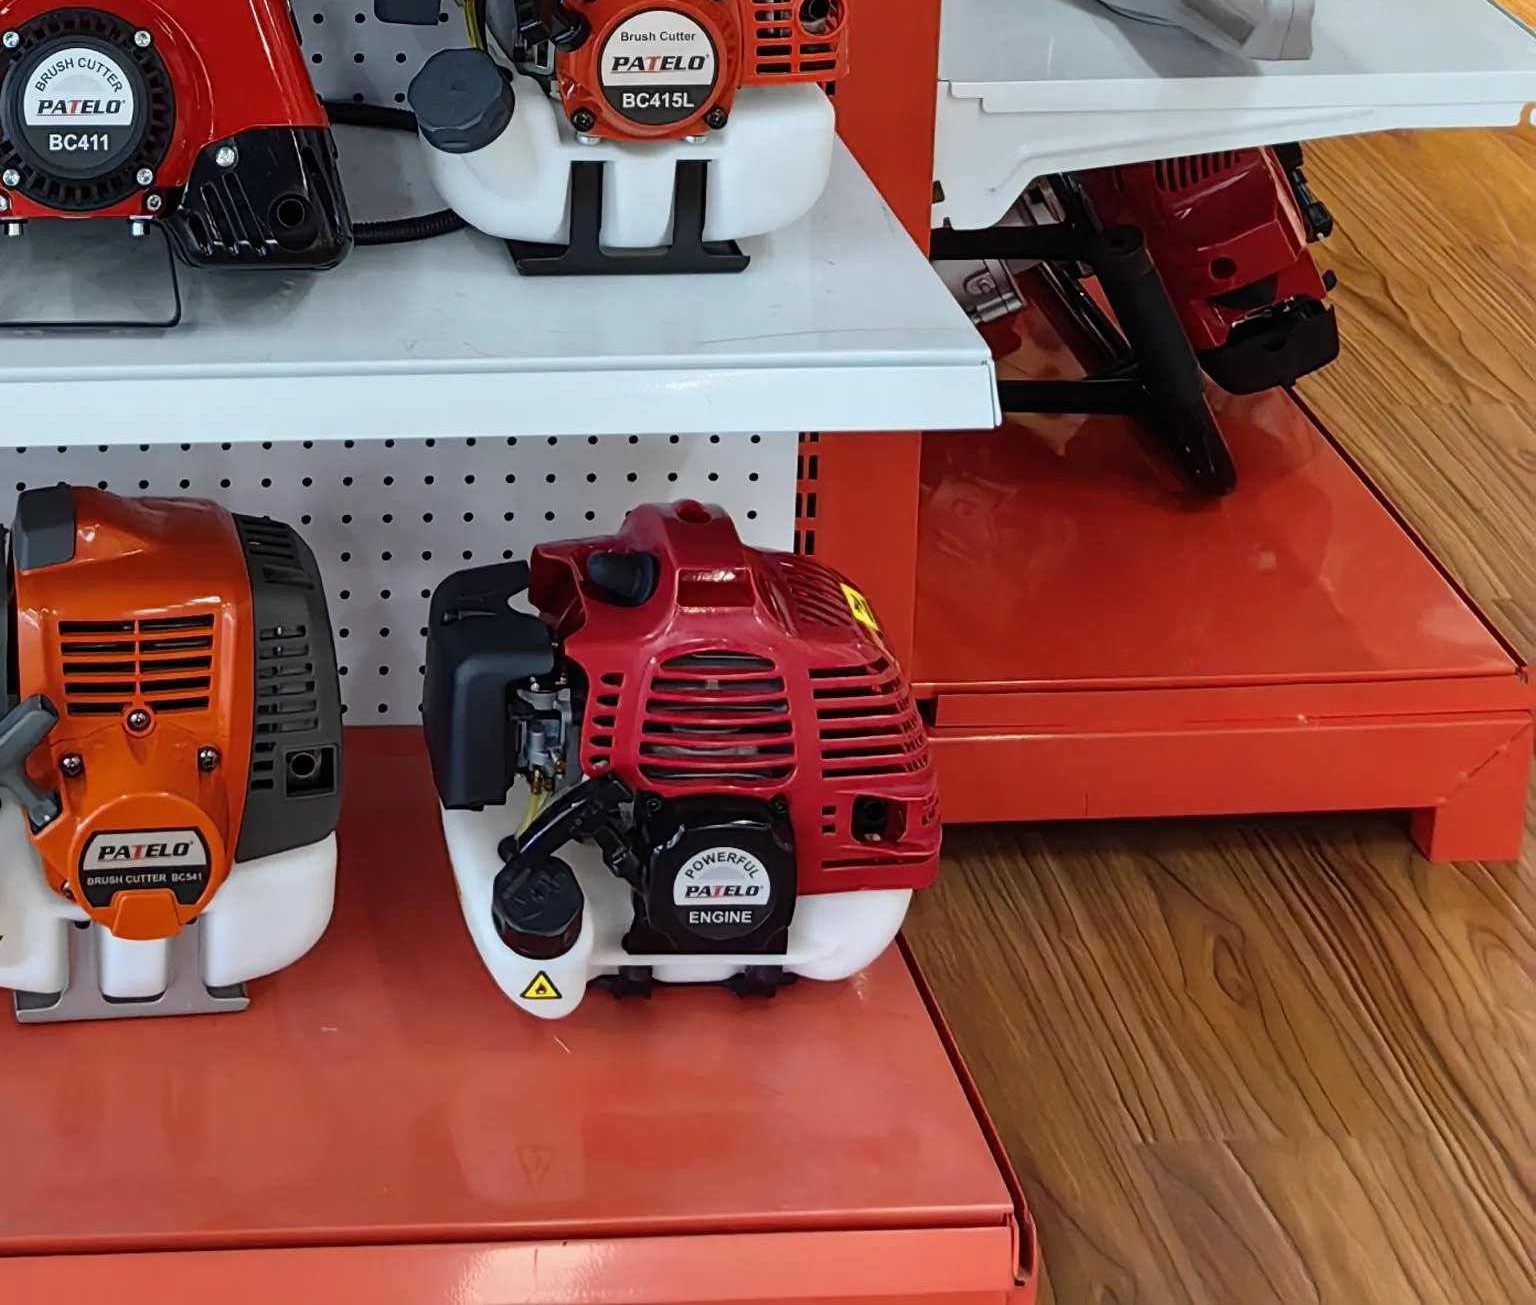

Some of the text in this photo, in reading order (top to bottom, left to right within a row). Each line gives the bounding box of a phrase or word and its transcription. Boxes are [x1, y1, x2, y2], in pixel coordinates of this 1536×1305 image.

[620, 31, 697, 42] Brush Cutter
[610, 55, 706, 74] PATELO
[35, 57, 124, 93] BRUSH CUTTER
[36, 99, 122, 117] PATELO
[622, 92, 695, 108] BC415L
[49, 133, 109, 151] BC411
[97, 842, 191, 863] PATELO
[684, 852, 759, 879] POWERFUL
[86, 872, 203, 886] BRUSH CUTTER BC541
[684, 885, 760, 899] PATELO
[689, 910, 753, 924] ENGINE
